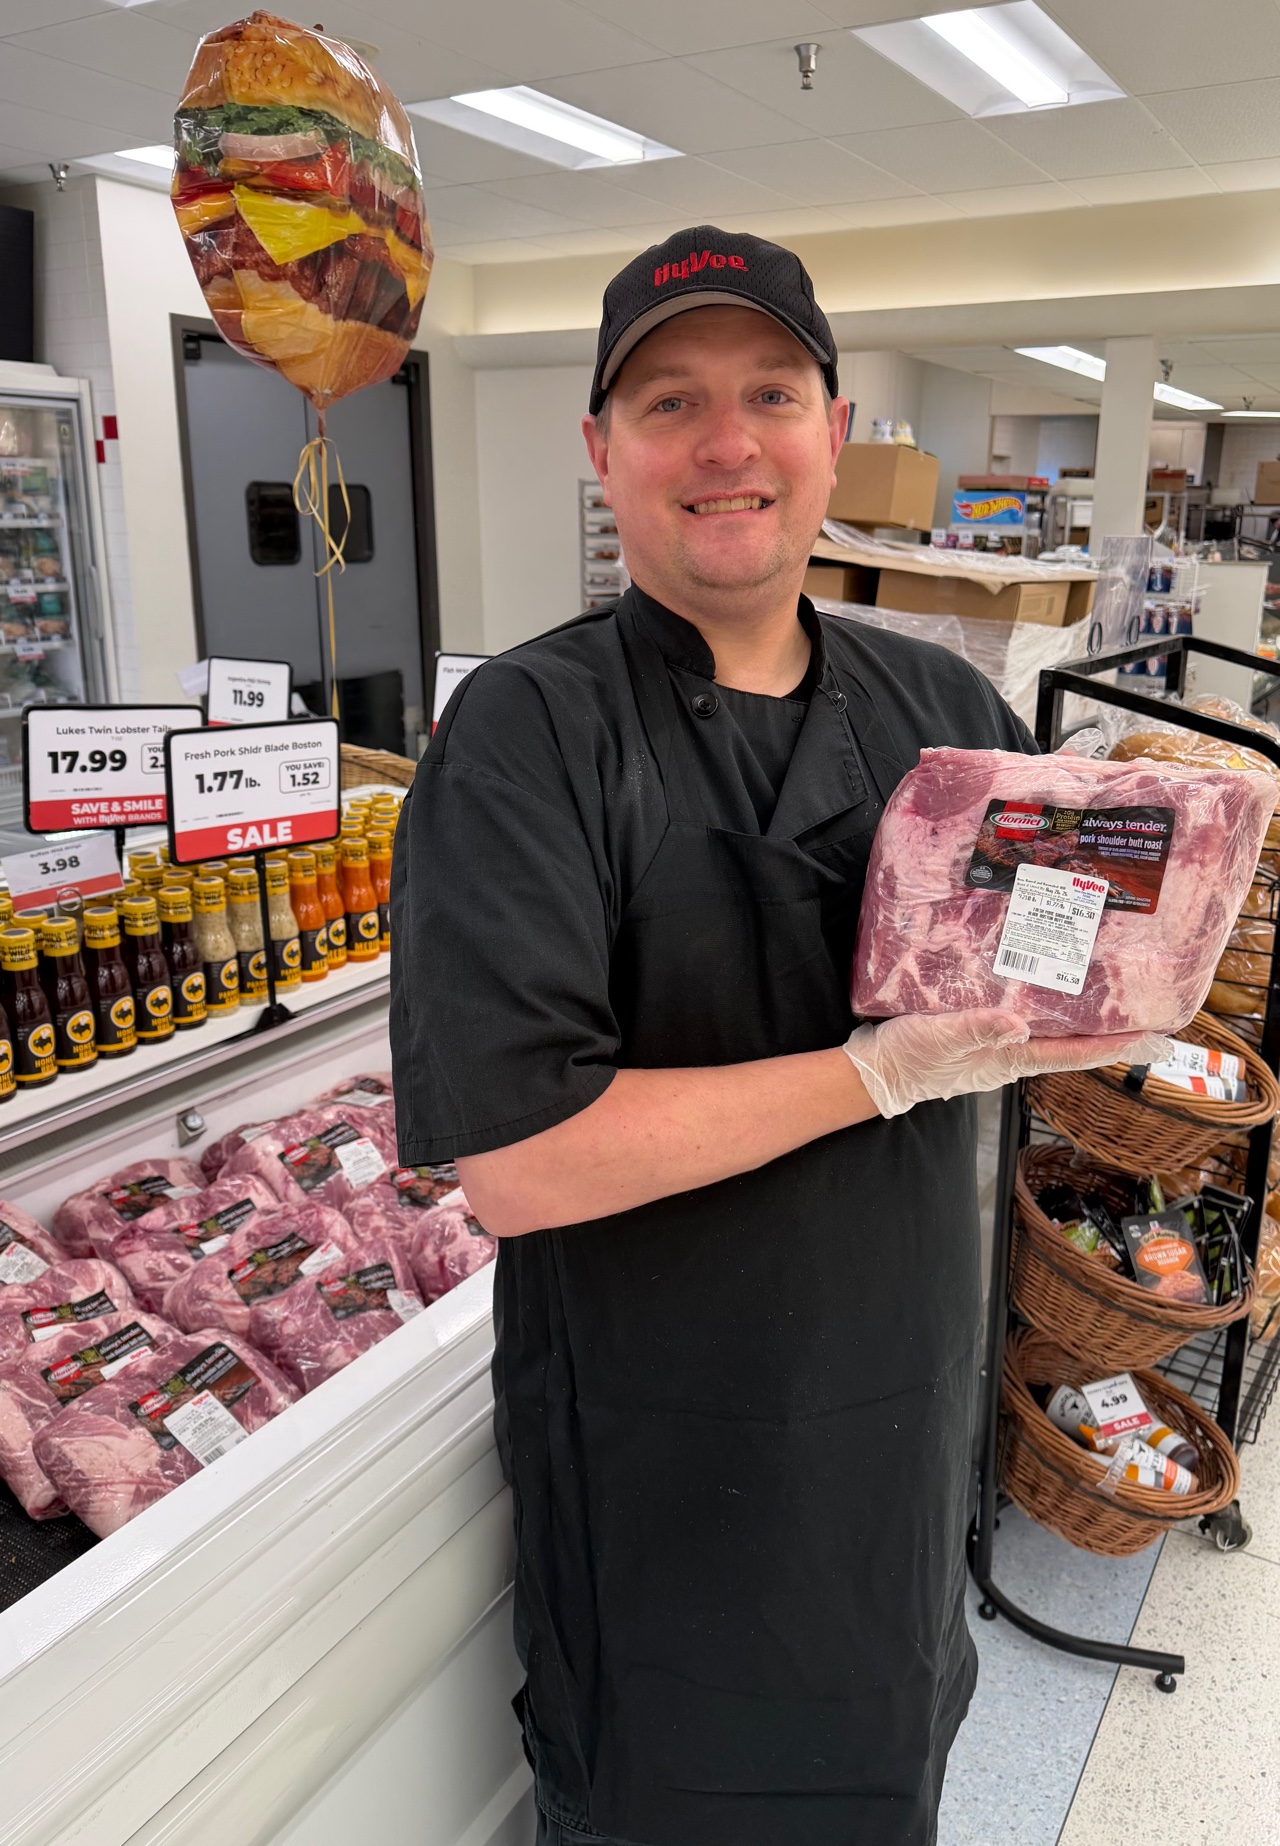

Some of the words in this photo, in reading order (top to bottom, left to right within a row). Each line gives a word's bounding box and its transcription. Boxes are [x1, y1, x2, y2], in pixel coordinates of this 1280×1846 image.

[653, 250, 748, 287] HyVee
[233, 689, 264, 708] 11.99
[56, 727, 86, 735] Lukes
[88, 726, 112, 734] Twin
[115, 726, 149, 735] Lobster
[184, 750, 211, 761] Fresh
[214, 748, 236, 759] Pork
[238, 746, 262, 756] Shldr
[264, 743, 289, 753] Blade
[292, 740, 322, 750] Boston
[47, 749, 127, 774] 17.99
[150, 757, 165, 768] 2.
[285, 763, 301, 771] YOU
[303, 761, 324, 770] SAVE:
[195, 769, 244, 794] 1.77
[245, 777, 261, 788] lb.
[290, 771, 319, 787] 1.52
[71, 802, 109, 815] SAVE
[111, 800, 122, 813] &
[123, 799, 163, 812] SMILE
[73, 816, 97, 825] WITH
[128, 812, 161, 822] BRANDS
[998, 814, 1042, 826] Hormel
[1082, 817, 1123, 831] always
[226, 820, 293, 850] SALE
[1079, 833, 1096, 844] pork
[1097, 835, 1127, 846] shoulder
[1128, 837, 1143, 848] butt
[1144, 839, 1162, 850] roast
[38, 855, 81, 875] 3.98
[1072, 877, 1105, 893] HyVee
[53, 1363, 78, 1379] Hormel
[143, 1395, 167, 1412] Hormel
[1101, 1393, 1128, 1408] 4.99
[1113, 1416, 1140, 1431] SALE
